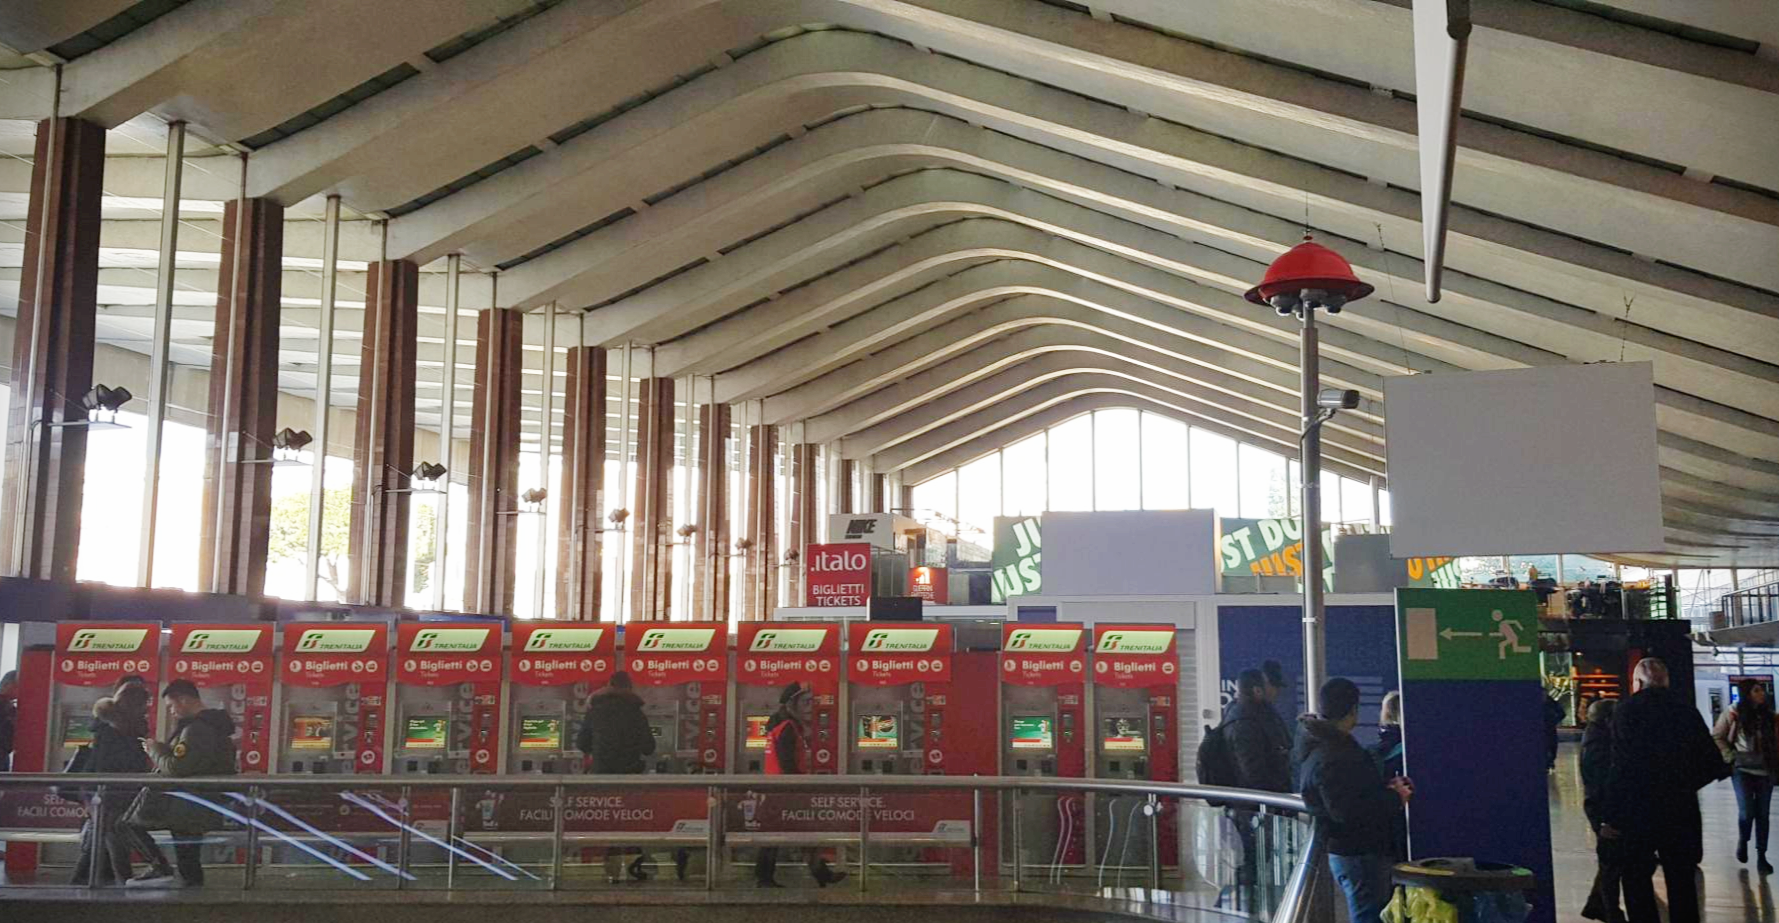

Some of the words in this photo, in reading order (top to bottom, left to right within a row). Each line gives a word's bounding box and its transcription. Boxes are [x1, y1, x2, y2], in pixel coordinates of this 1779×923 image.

[846, 519, 878, 534] NIKE
[1012, 516, 1041, 557] JU
[812, 584, 864, 595] BIGLIETTI
[816, 596, 861, 606] TICKETS
[77, 660, 119, 672] Biglietti
[191, 660, 234, 672] Biglietti
[305, 660, 348, 672] Biglietti
[420, 660, 462, 672] Biglietti
[534, 660, 577, 672] Biglietti
[648, 660, 690, 672] Biglietti
[760, 660, 802, 672] Biglietti
[872, 660, 913, 672] Biglietti
[1022, 660, 1064, 672] Biglietti
[1114, 662, 1156, 673] Biglietti
[810, 797, 835, 808] SELF
[17, 806, 47, 817] FACILI
[520, 809, 553, 820] FACILI
[564, 809, 610, 820] OMODE
[612, 809, 654, 820] VELOCI
[782, 810, 814, 821] FACILI
[874, 810, 914, 821] VELOCI
